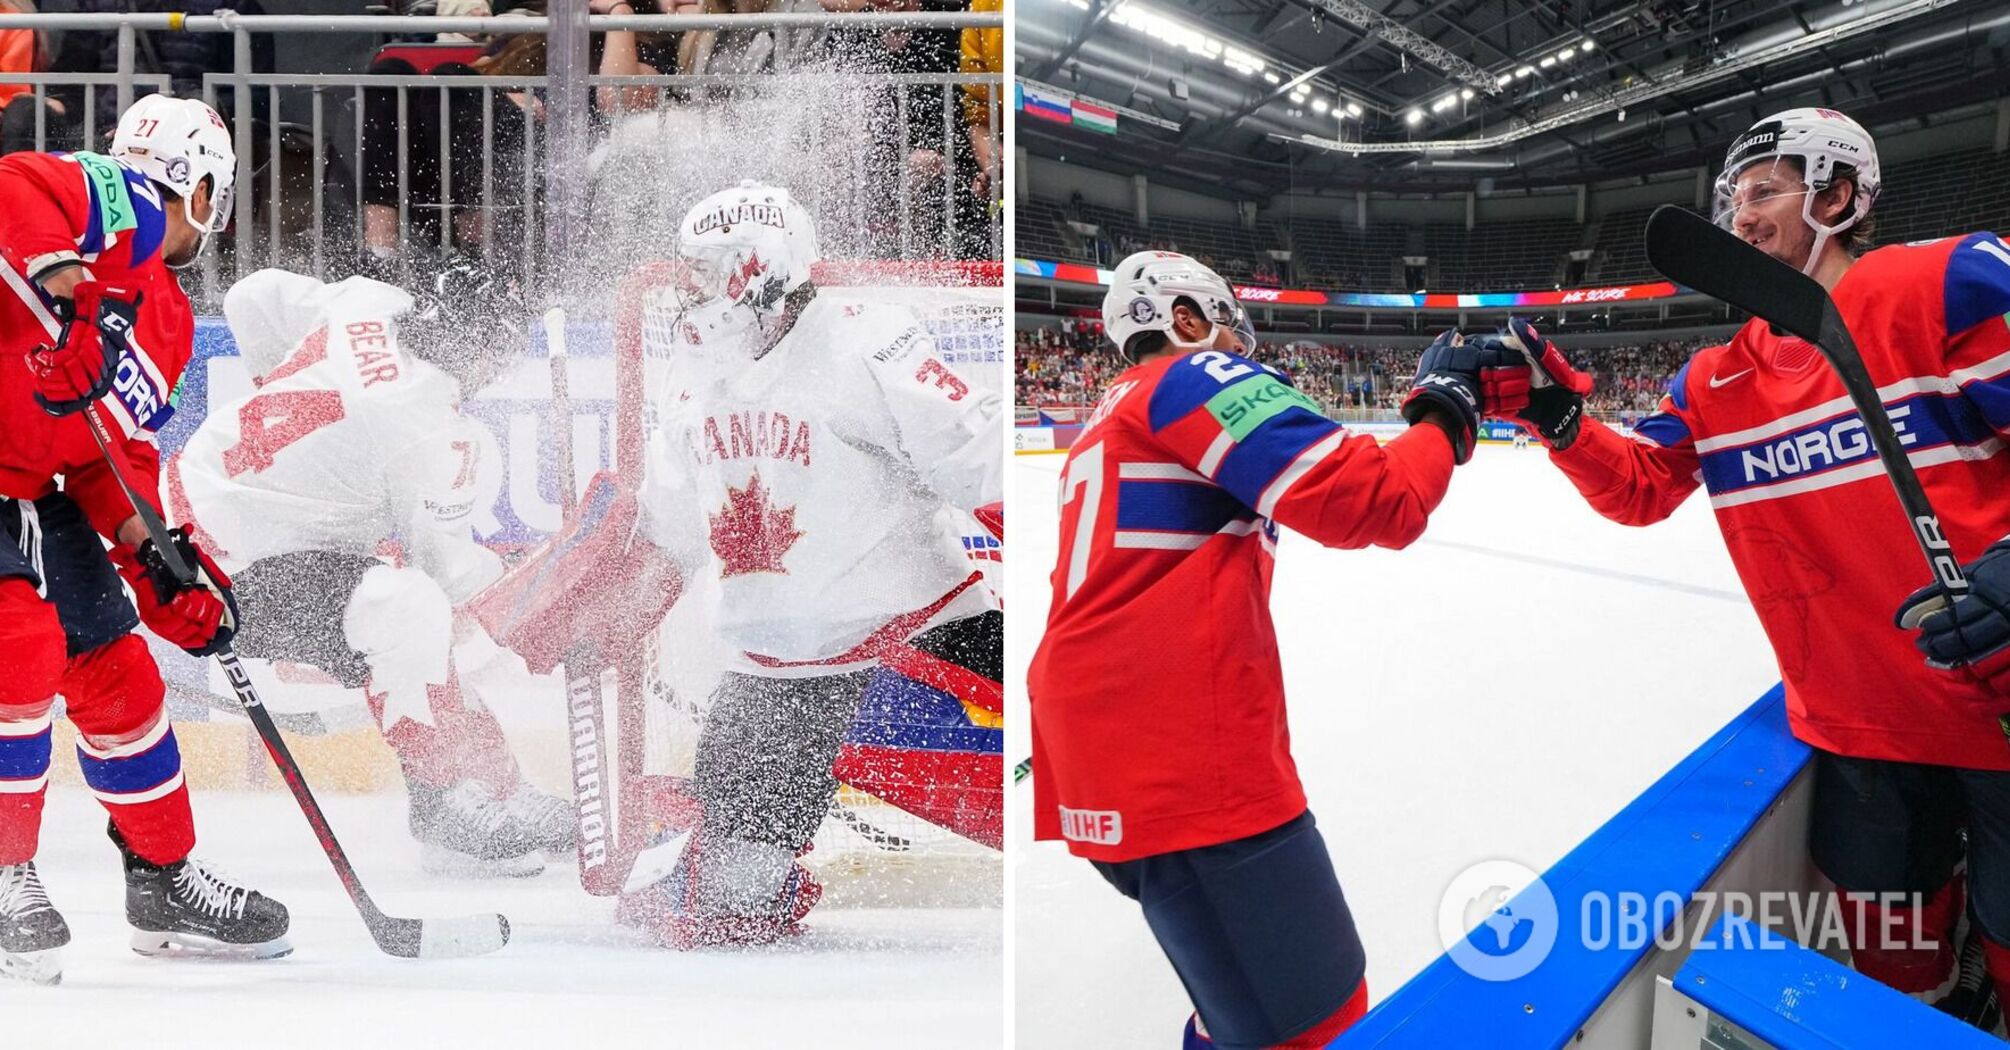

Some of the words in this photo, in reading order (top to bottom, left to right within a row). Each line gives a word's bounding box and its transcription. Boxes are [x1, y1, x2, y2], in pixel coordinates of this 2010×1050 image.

[133, 118, 160, 138] 27
[206, 149, 225, 160] CCM
[1827, 139, 1860, 153] CCM
[693, 204, 785, 236] CANADA
[345, 321, 399, 388] BEAR
[1553, 403, 1578, 435] CCM
[570, 676, 607, 871] WARRIOR
